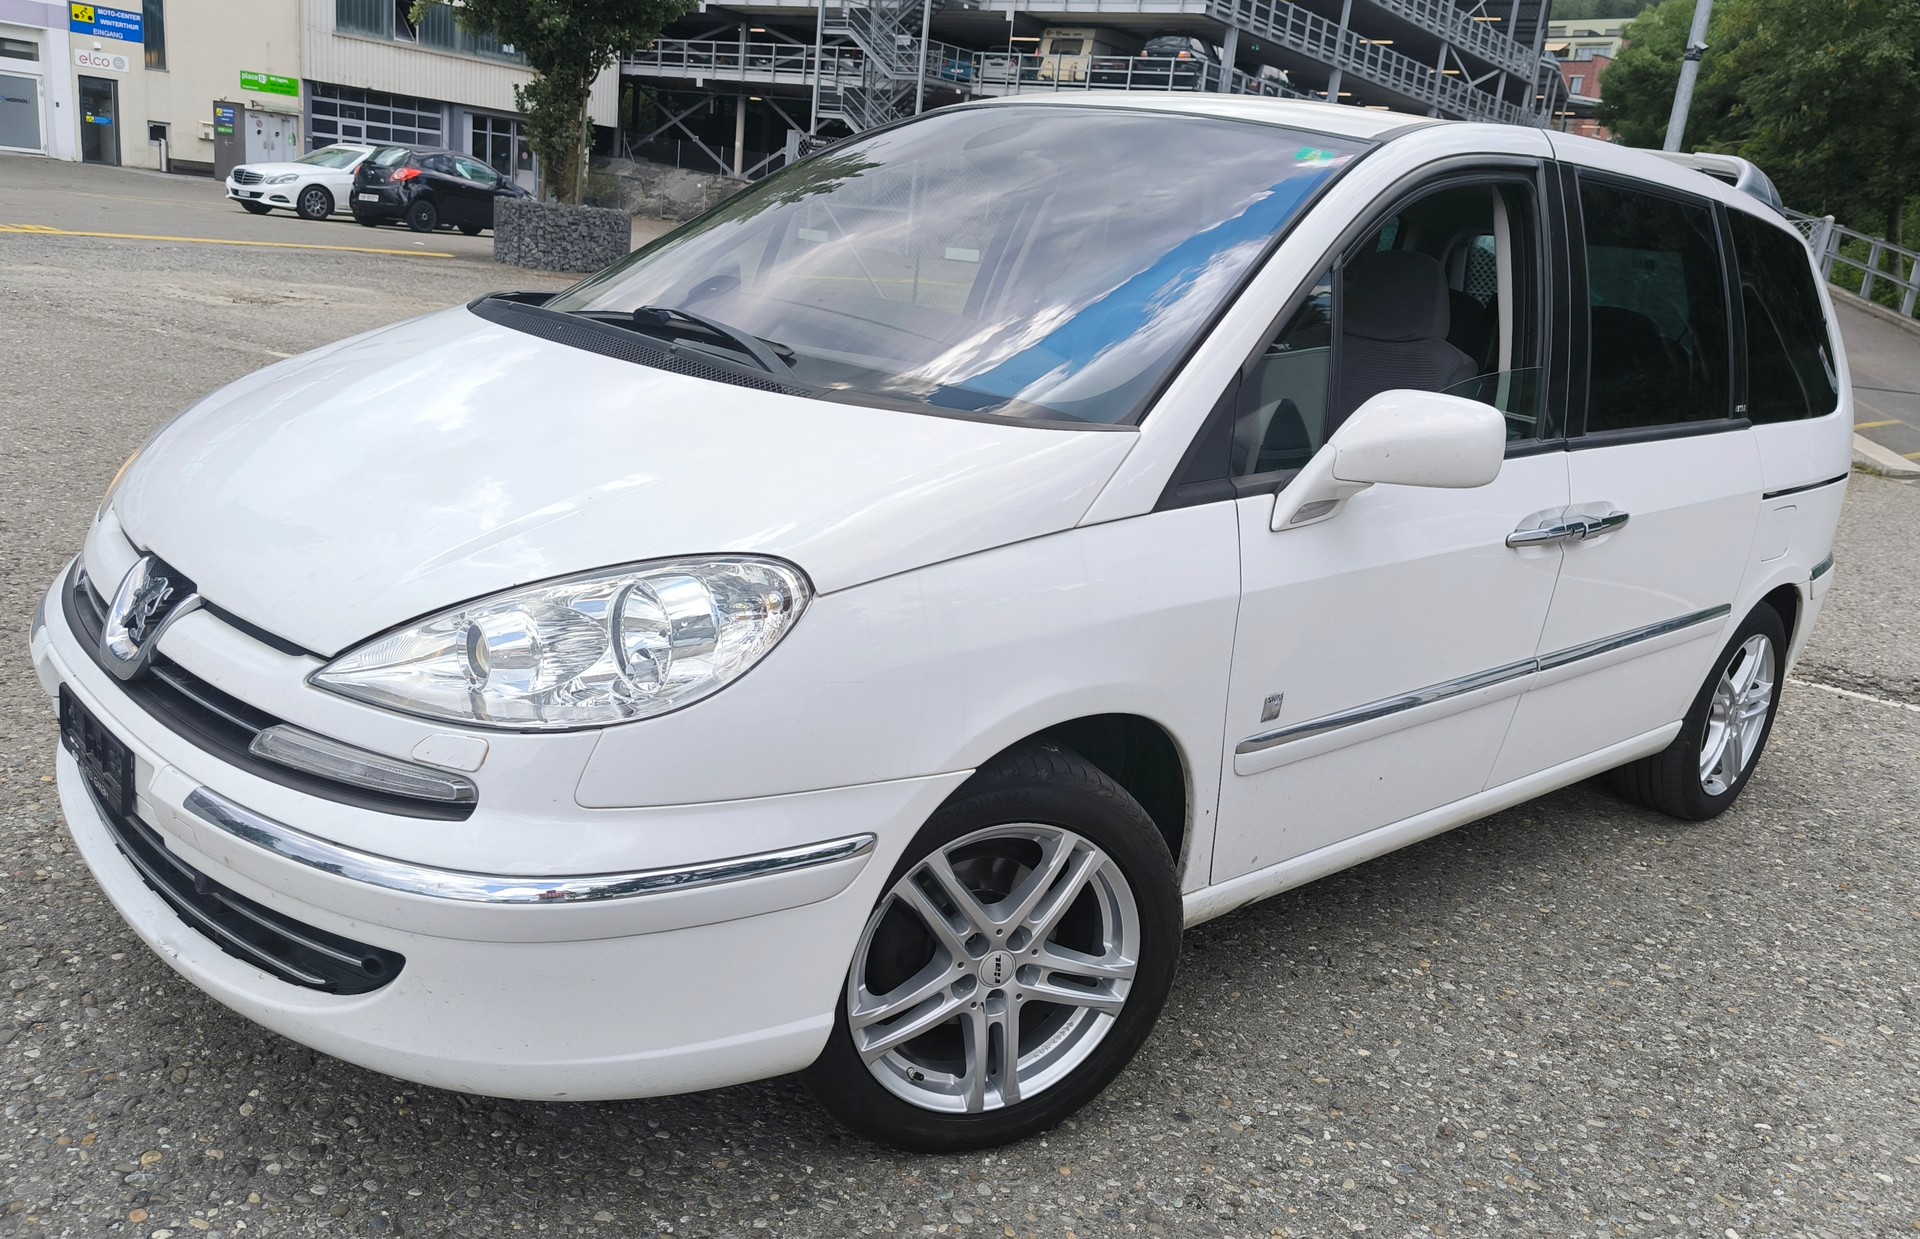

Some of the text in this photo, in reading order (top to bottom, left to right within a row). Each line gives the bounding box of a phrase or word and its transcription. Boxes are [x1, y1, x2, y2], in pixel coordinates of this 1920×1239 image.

[97, 8, 141, 21] MOTO-CENTER
[99, 18, 140, 31] WINTERTHUR
[92, 28, 124, 39] EINGANG
[79, 52, 110, 67] elco
[1268, 691, 1284, 704] SWISS
